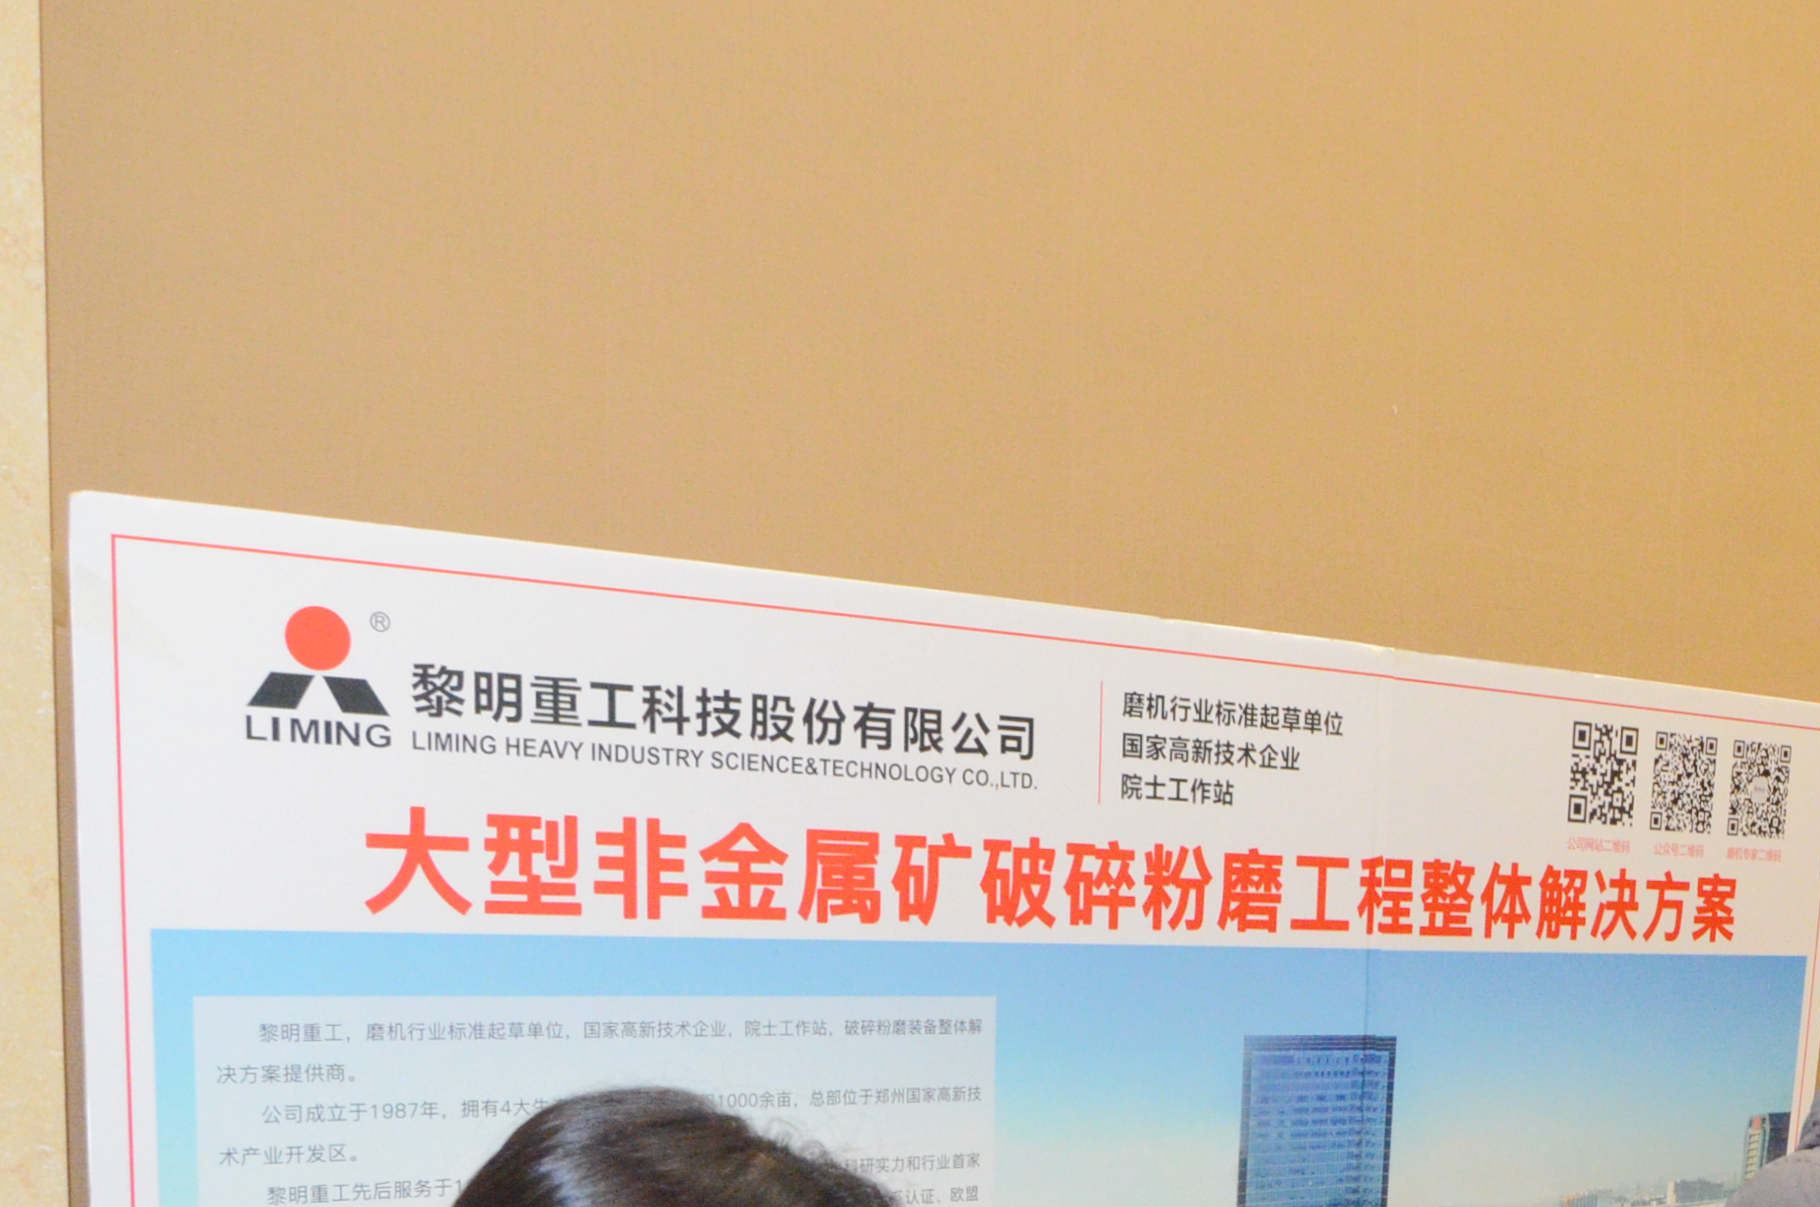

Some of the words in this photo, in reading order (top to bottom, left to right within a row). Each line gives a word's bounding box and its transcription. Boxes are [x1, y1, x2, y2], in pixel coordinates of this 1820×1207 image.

[245, 713, 393, 749] LIMING
[411, 663, 1037, 762] 黎明重工科技股份有限公司
[1121, 691, 1344, 737] 磨机行业标准起草单位
[411, 732, 497, 756] LIMING
[504, 737, 583, 762] HEAVY
[590, 742, 702, 770] INDUSTRY
[710, 752, 957, 787] SCIENCE&TECHNOLOGY
[962, 765, 1039, 791] CO.,LTD.
[1121, 732, 1301, 772] 国家高新技术企业
[1120, 773, 1234, 807] 院士工作站
[364, 805, 1738, 943] 大型非金属矿破碎粉磨工程整体解决方案
[216, 1063, 357, 1085] 决方案提供商。
[218, 1143, 358, 1167] 术产业开发区。
